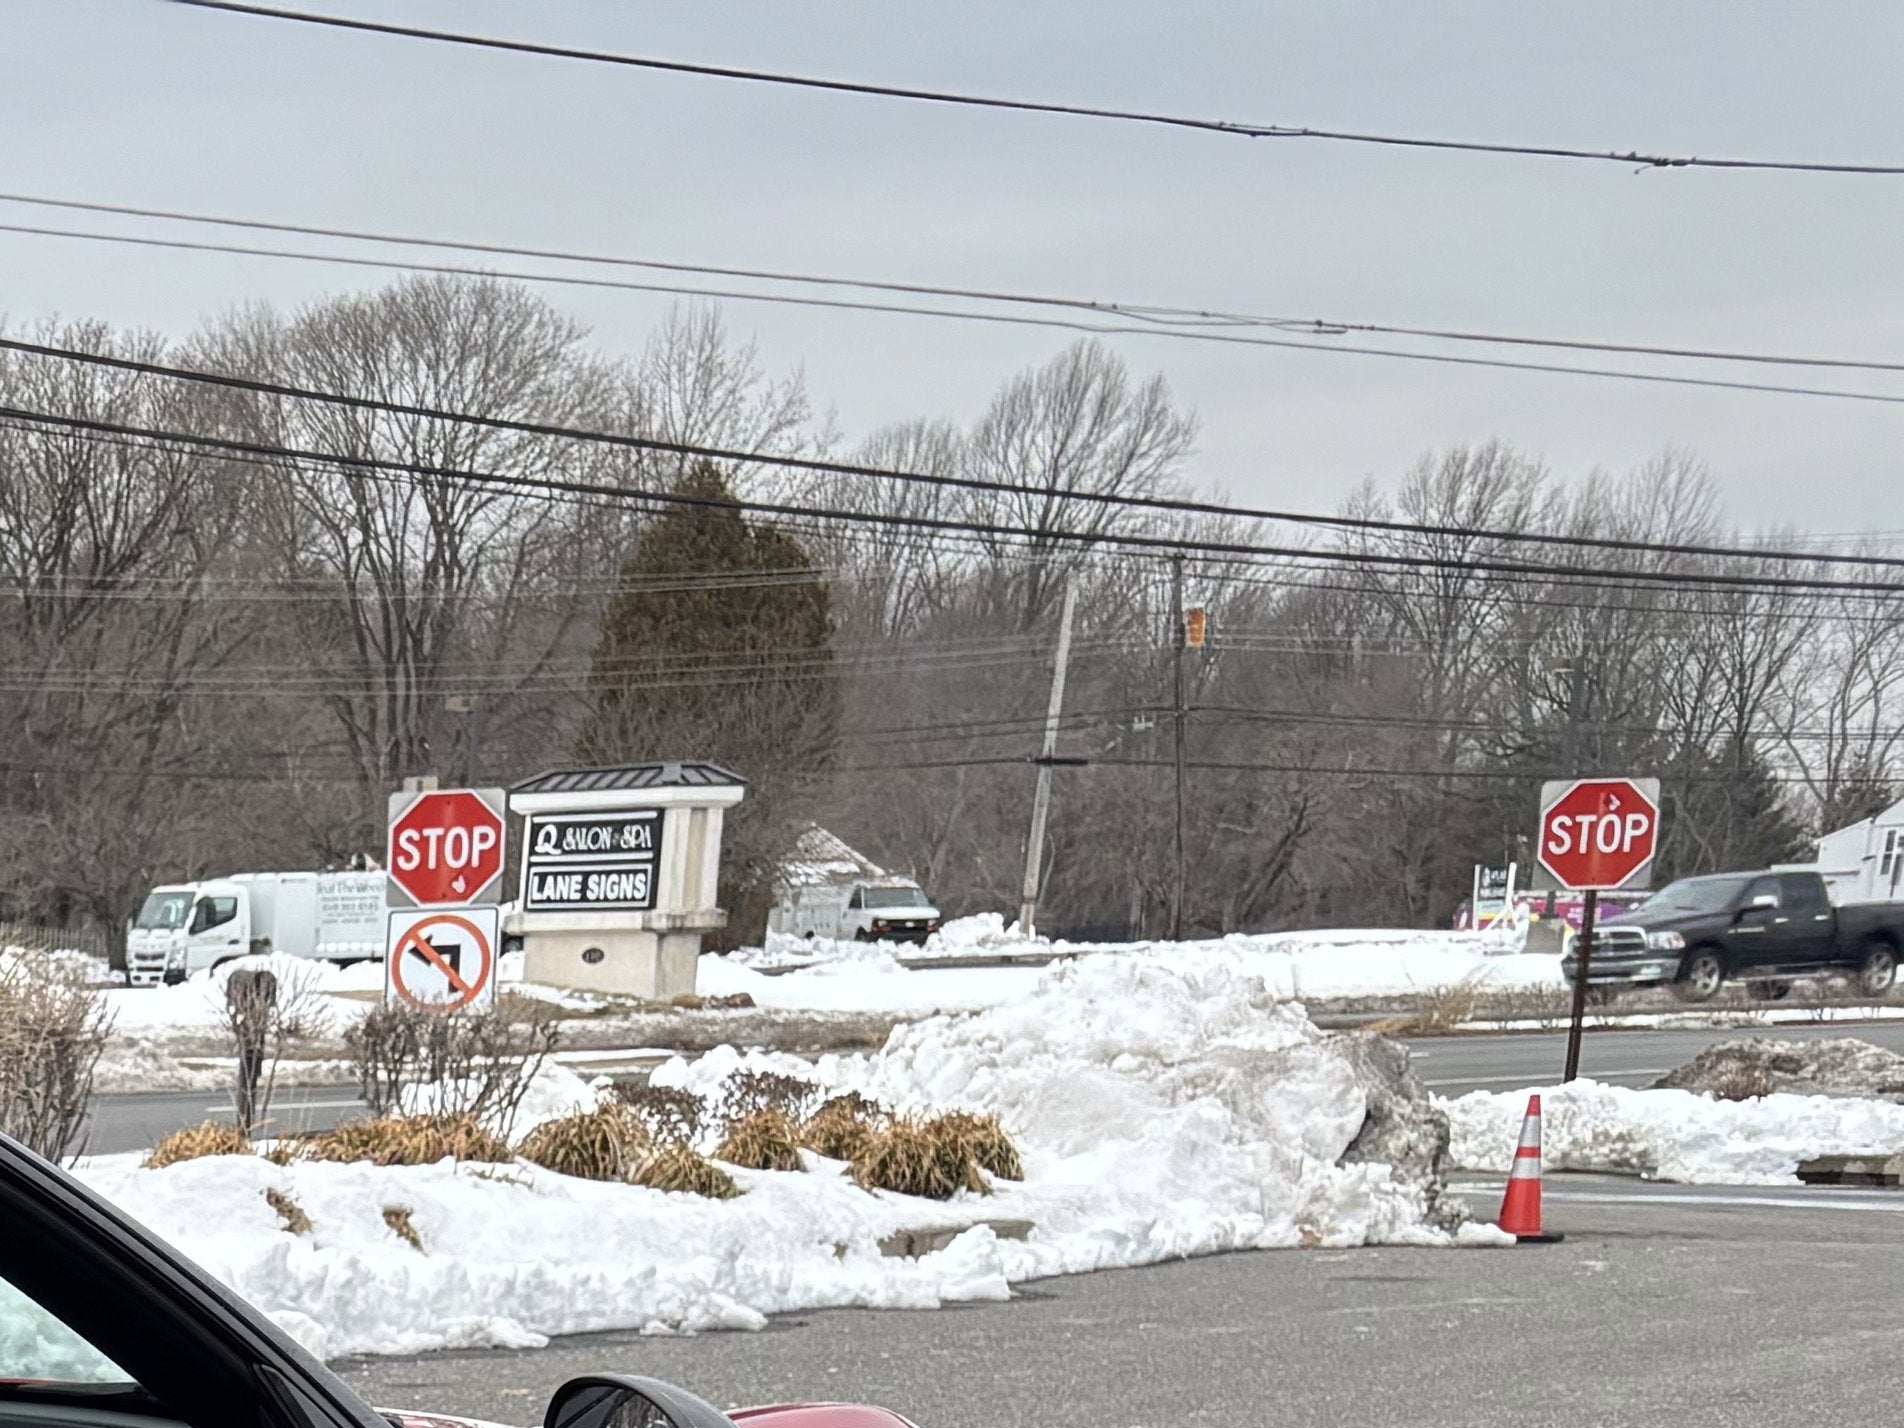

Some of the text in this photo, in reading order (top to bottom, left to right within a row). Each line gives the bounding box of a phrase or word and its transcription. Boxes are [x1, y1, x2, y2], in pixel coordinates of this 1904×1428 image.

[397, 825, 496, 871] STOP
[534, 824, 562, 855] Q
[563, 826, 613, 851] SALON
[620, 824, 652, 849] SPA
[1548, 813, 1649, 855] STOP
[532, 873, 646, 900] LANE SIGNS
